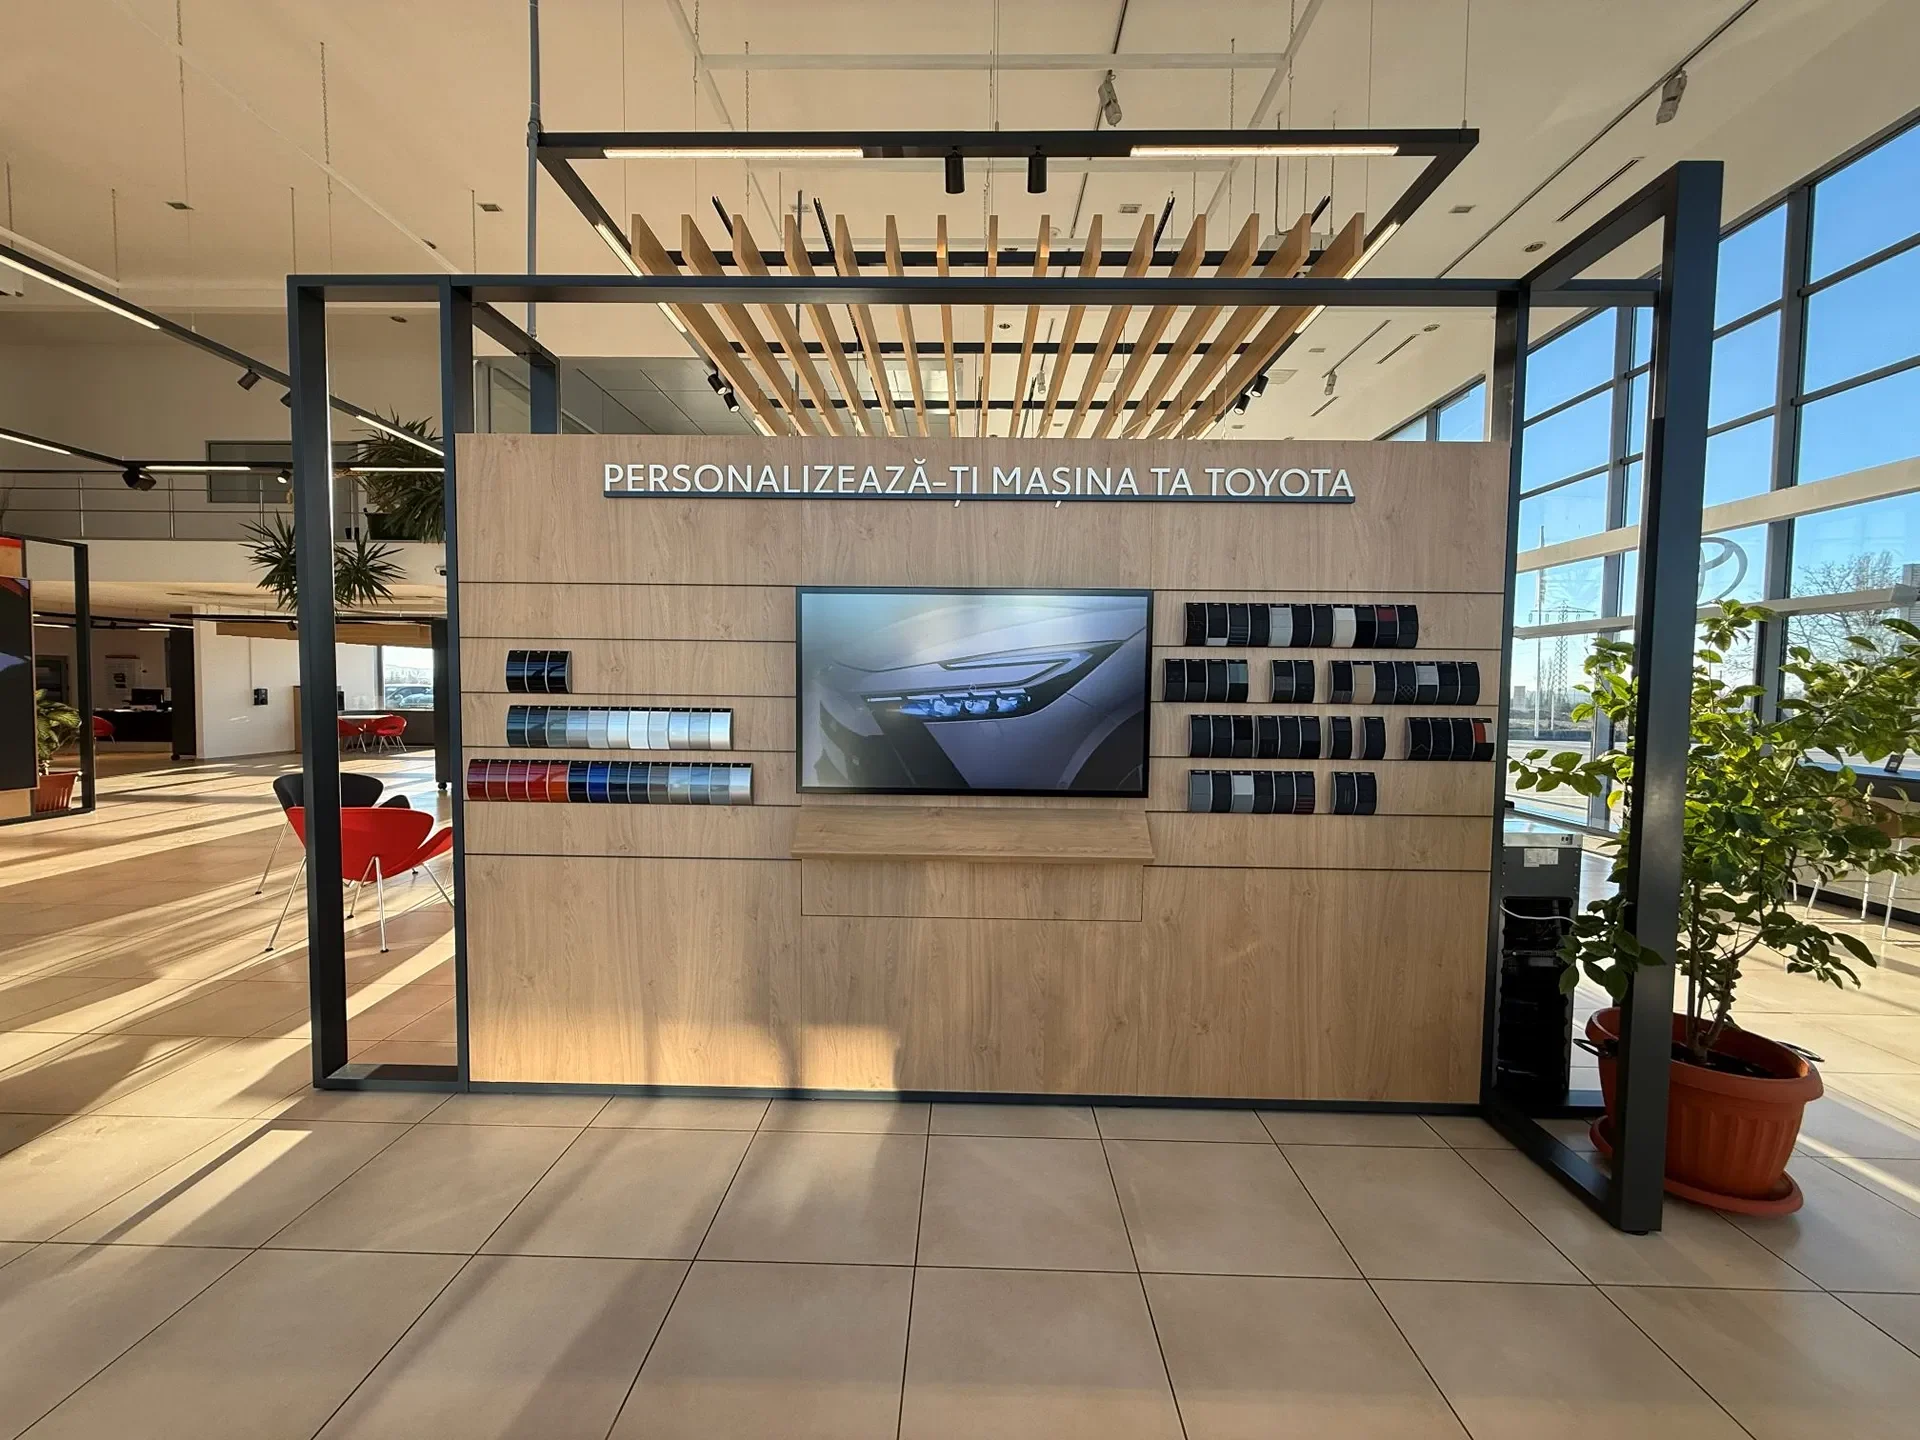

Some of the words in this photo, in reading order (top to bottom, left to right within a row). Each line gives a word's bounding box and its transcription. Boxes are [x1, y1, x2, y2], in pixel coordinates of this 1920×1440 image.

[604, 458, 978, 508] PERSONALIZEAZĂ-ȚI
[992, 466, 1139, 508] MAȘINA
[1150, 467, 1194, 496] TA
[1204, 468, 1355, 497] TOYOTA
